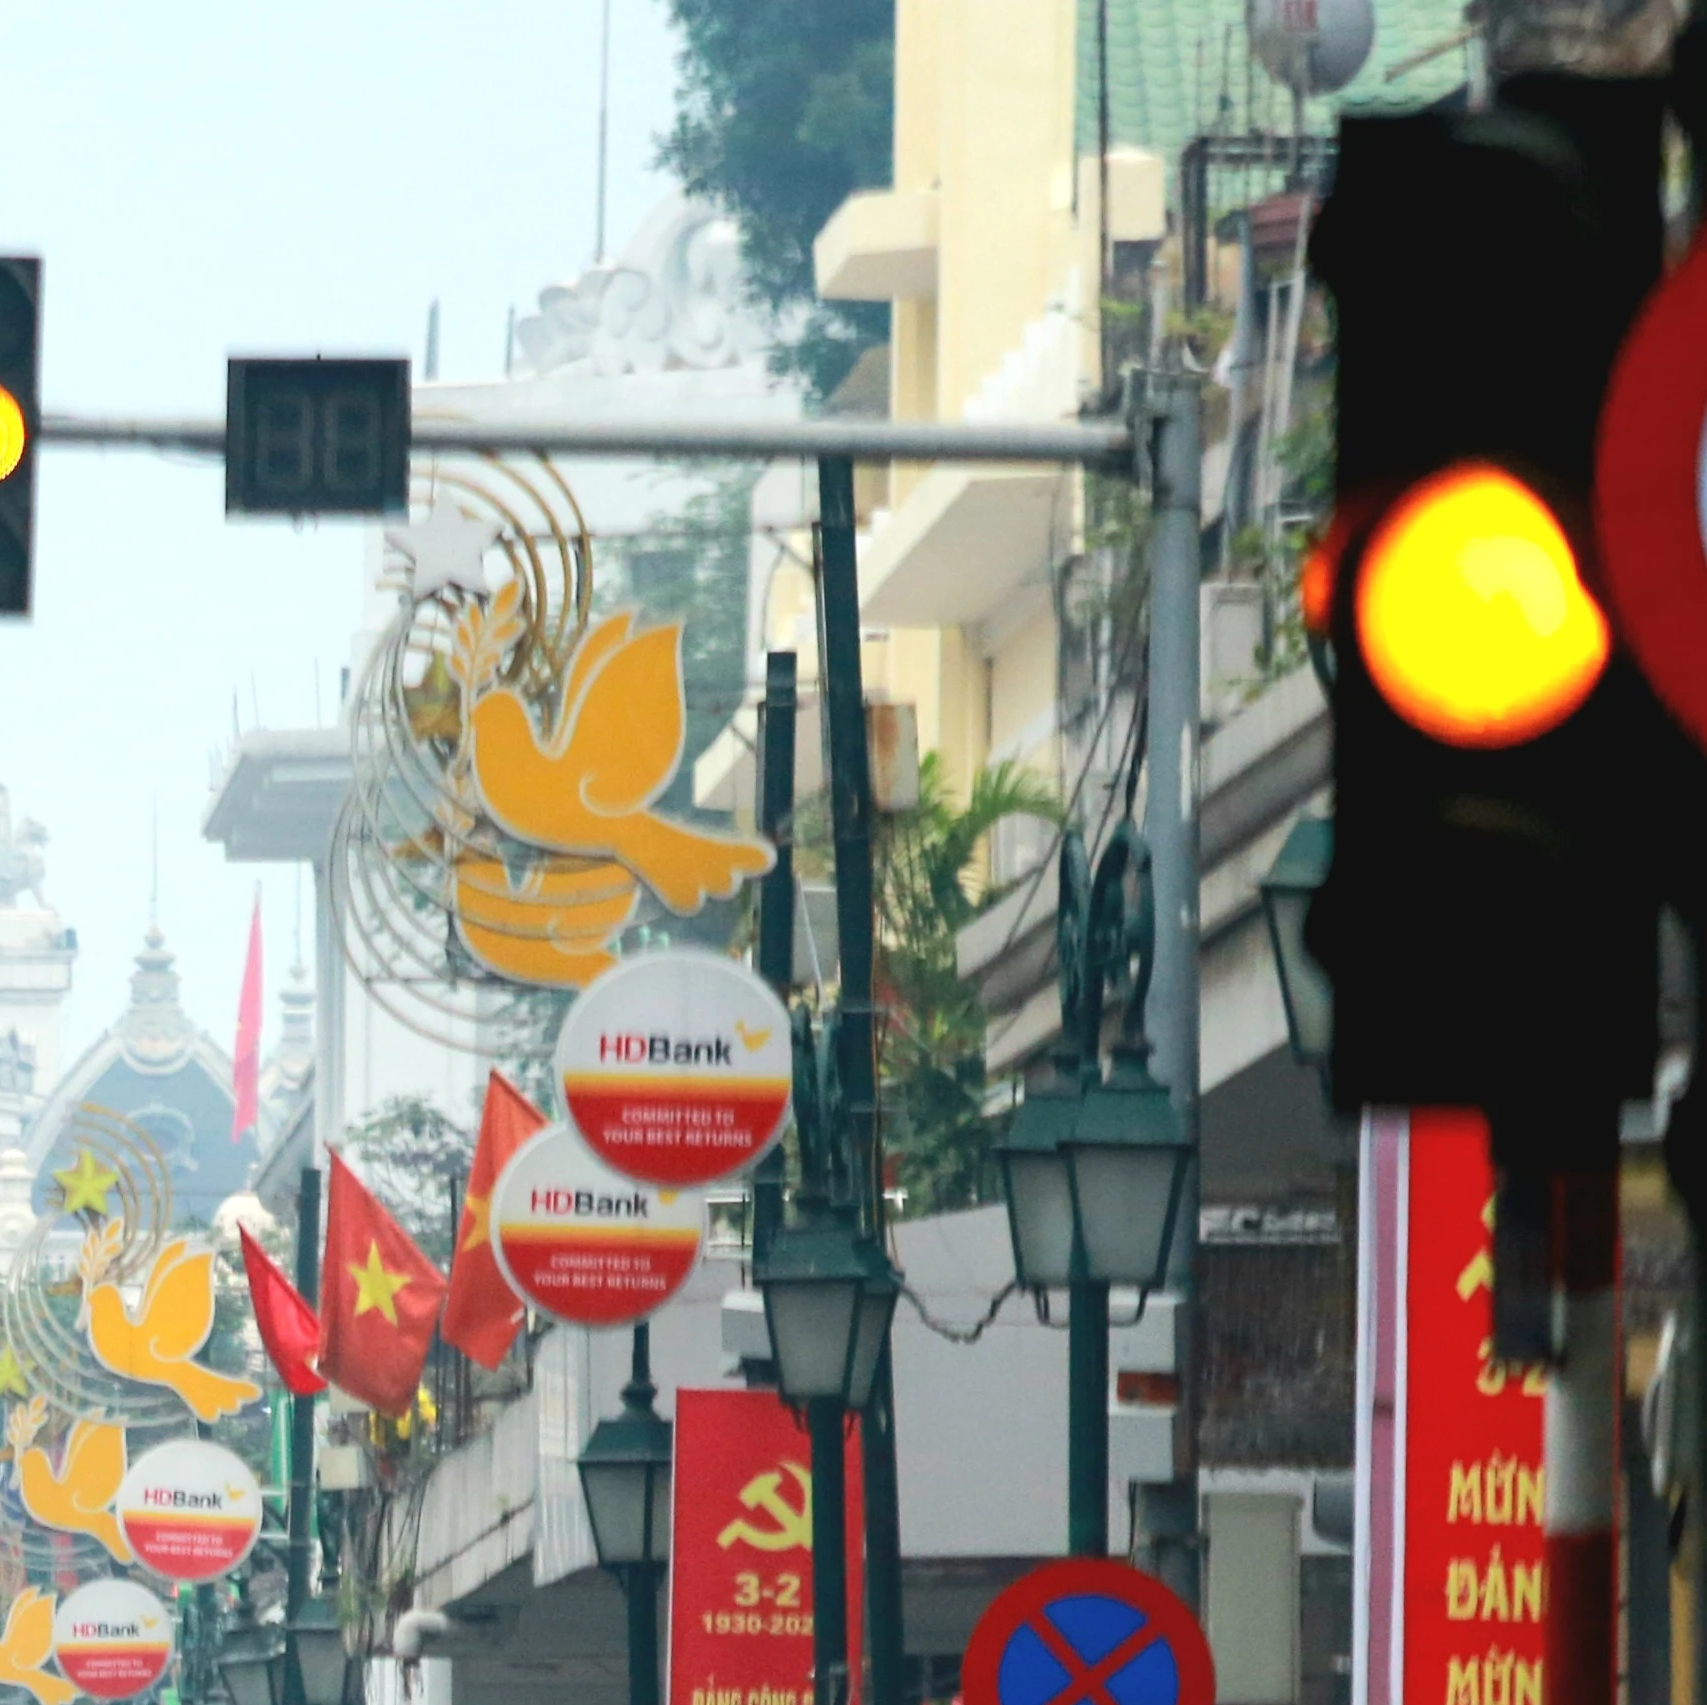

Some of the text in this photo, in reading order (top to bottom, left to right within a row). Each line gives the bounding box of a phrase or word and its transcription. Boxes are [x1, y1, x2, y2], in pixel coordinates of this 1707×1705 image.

[599, 1033, 734, 1066] HDBank
[622, 1106, 735, 1126] COMMITTED TO
[602, 1128, 752, 1148] YOUR BEST RETURNS
[531, 1188, 649, 1218] HDBank
[549, 1254, 652, 1272] COMMITTED TO
[533, 1273, 667, 1292] YOUR BEST RETURNS
[1446, 1449, 1545, 1527] MỪN
[144, 1489, 223, 1510] HDBank
[734, 1573, 801, 1607] 3-2
[1445, 1544, 1544, 1622] ĐẢN
[72, 1622, 141, 1639] HDBank
[702, 1612, 814, 1635] 1930-202
